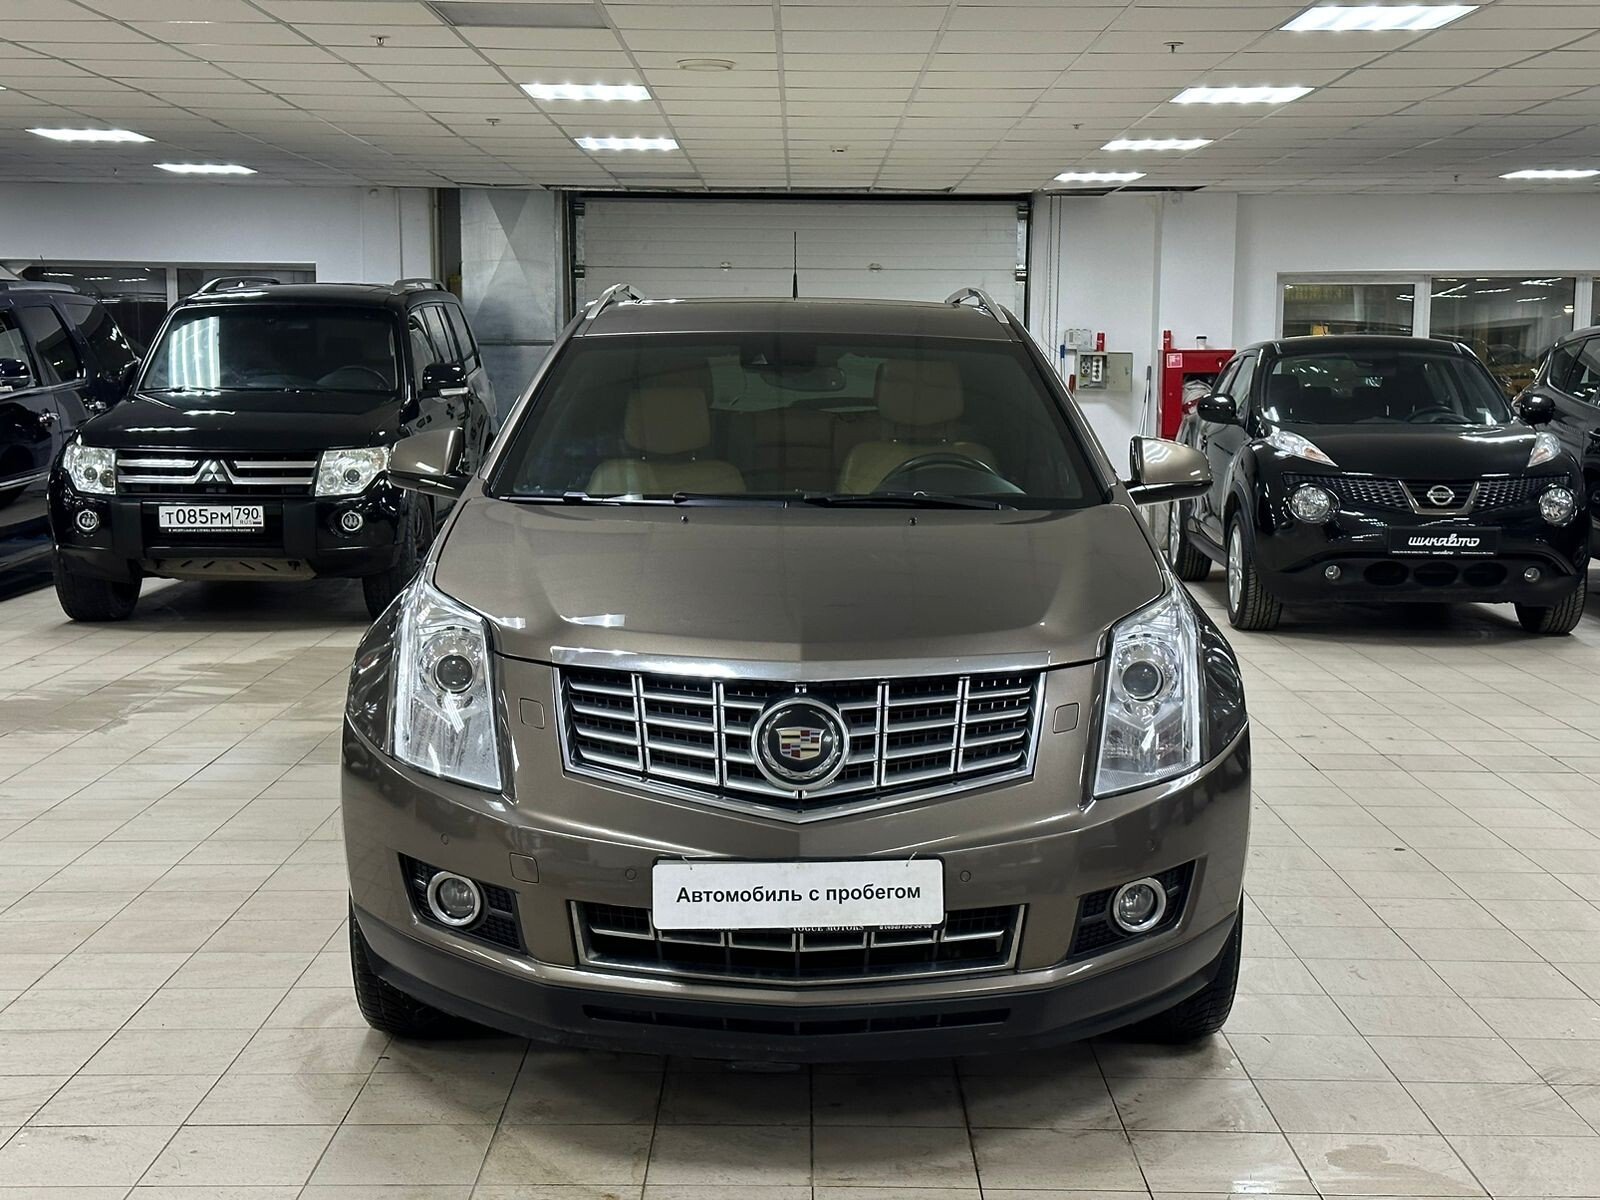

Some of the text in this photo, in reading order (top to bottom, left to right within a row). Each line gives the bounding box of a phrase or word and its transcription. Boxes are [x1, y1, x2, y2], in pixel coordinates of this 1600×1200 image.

[165, 507, 260, 525] Т085РМ 790
[676, 884, 922, 904] Автомобиль с пробегом
